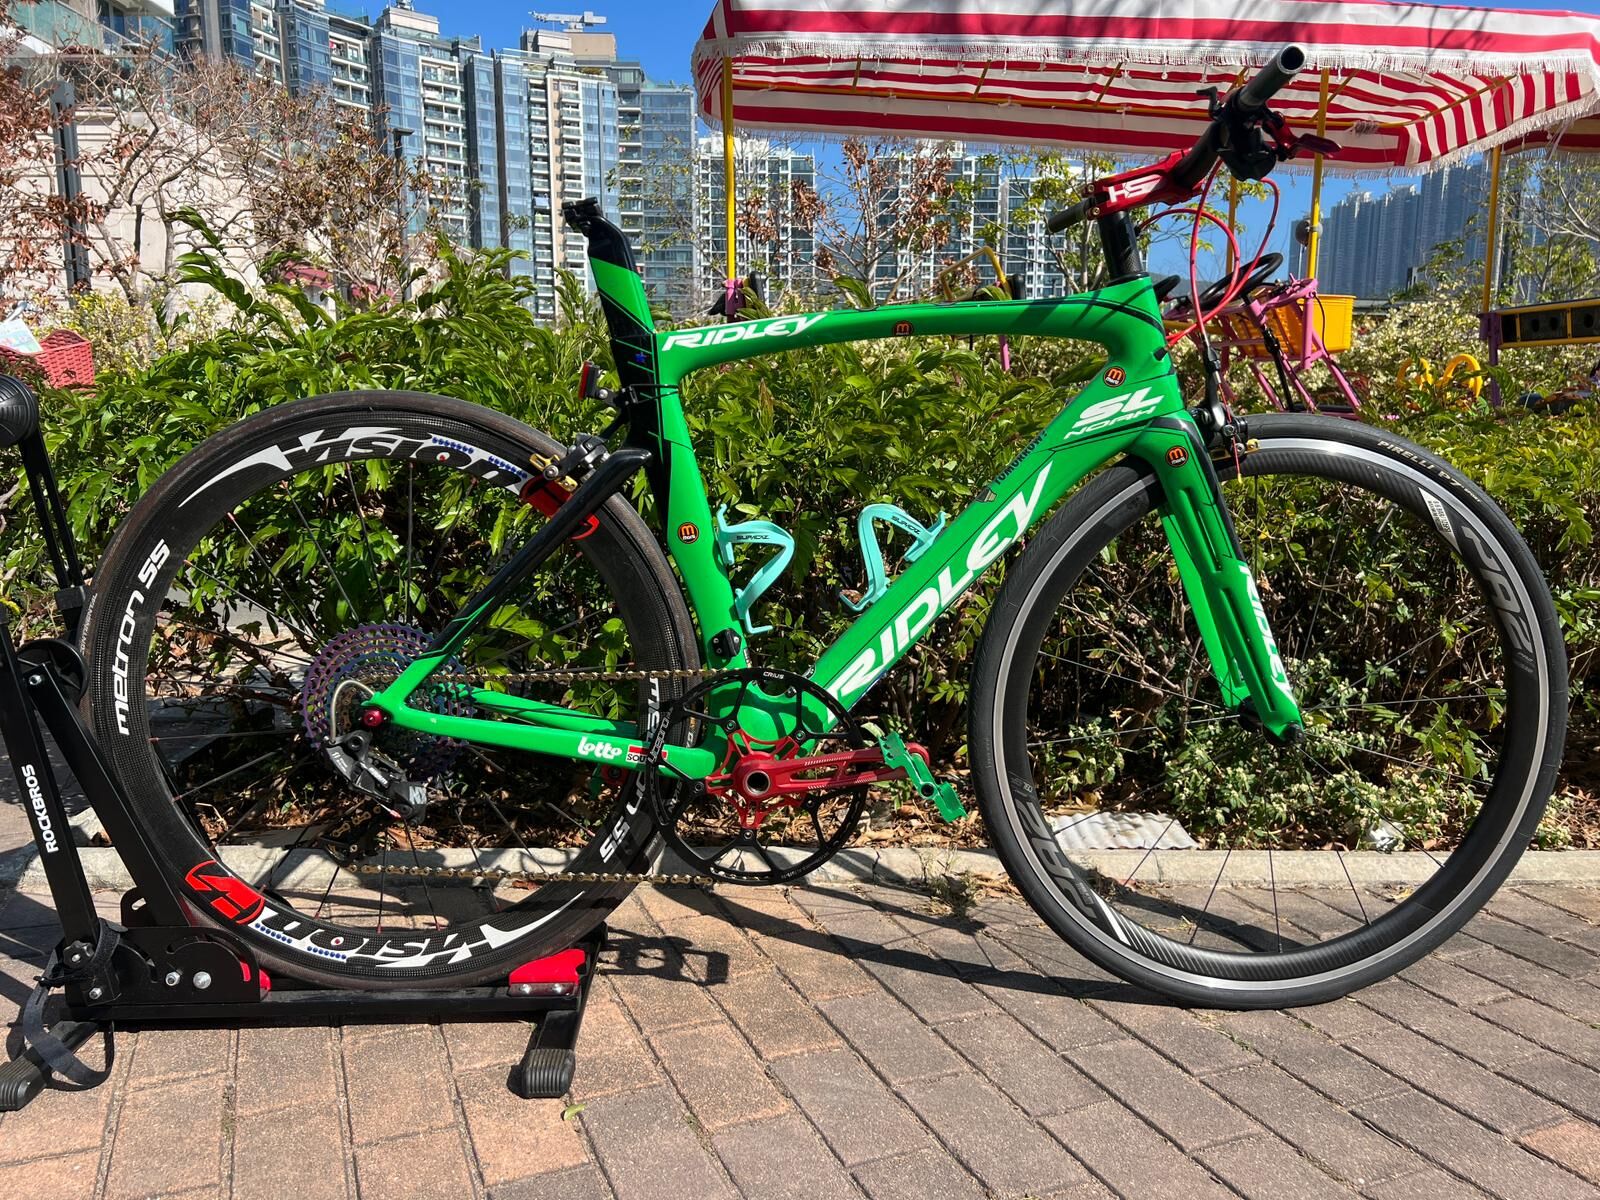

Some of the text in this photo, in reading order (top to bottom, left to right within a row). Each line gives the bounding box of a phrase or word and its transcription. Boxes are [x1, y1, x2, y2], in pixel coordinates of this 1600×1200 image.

[662, 313, 828, 351] RIDLEY
[1072, 386, 1165, 428] SL
[1377, 440, 1436, 471] PIRELLI
[826, 460, 1053, 724] RIDLEY
[114, 590, 145, 736] metron
[763, 671, 785, 680] CRIUS
[21, 764, 59, 853] ROCKBROS
